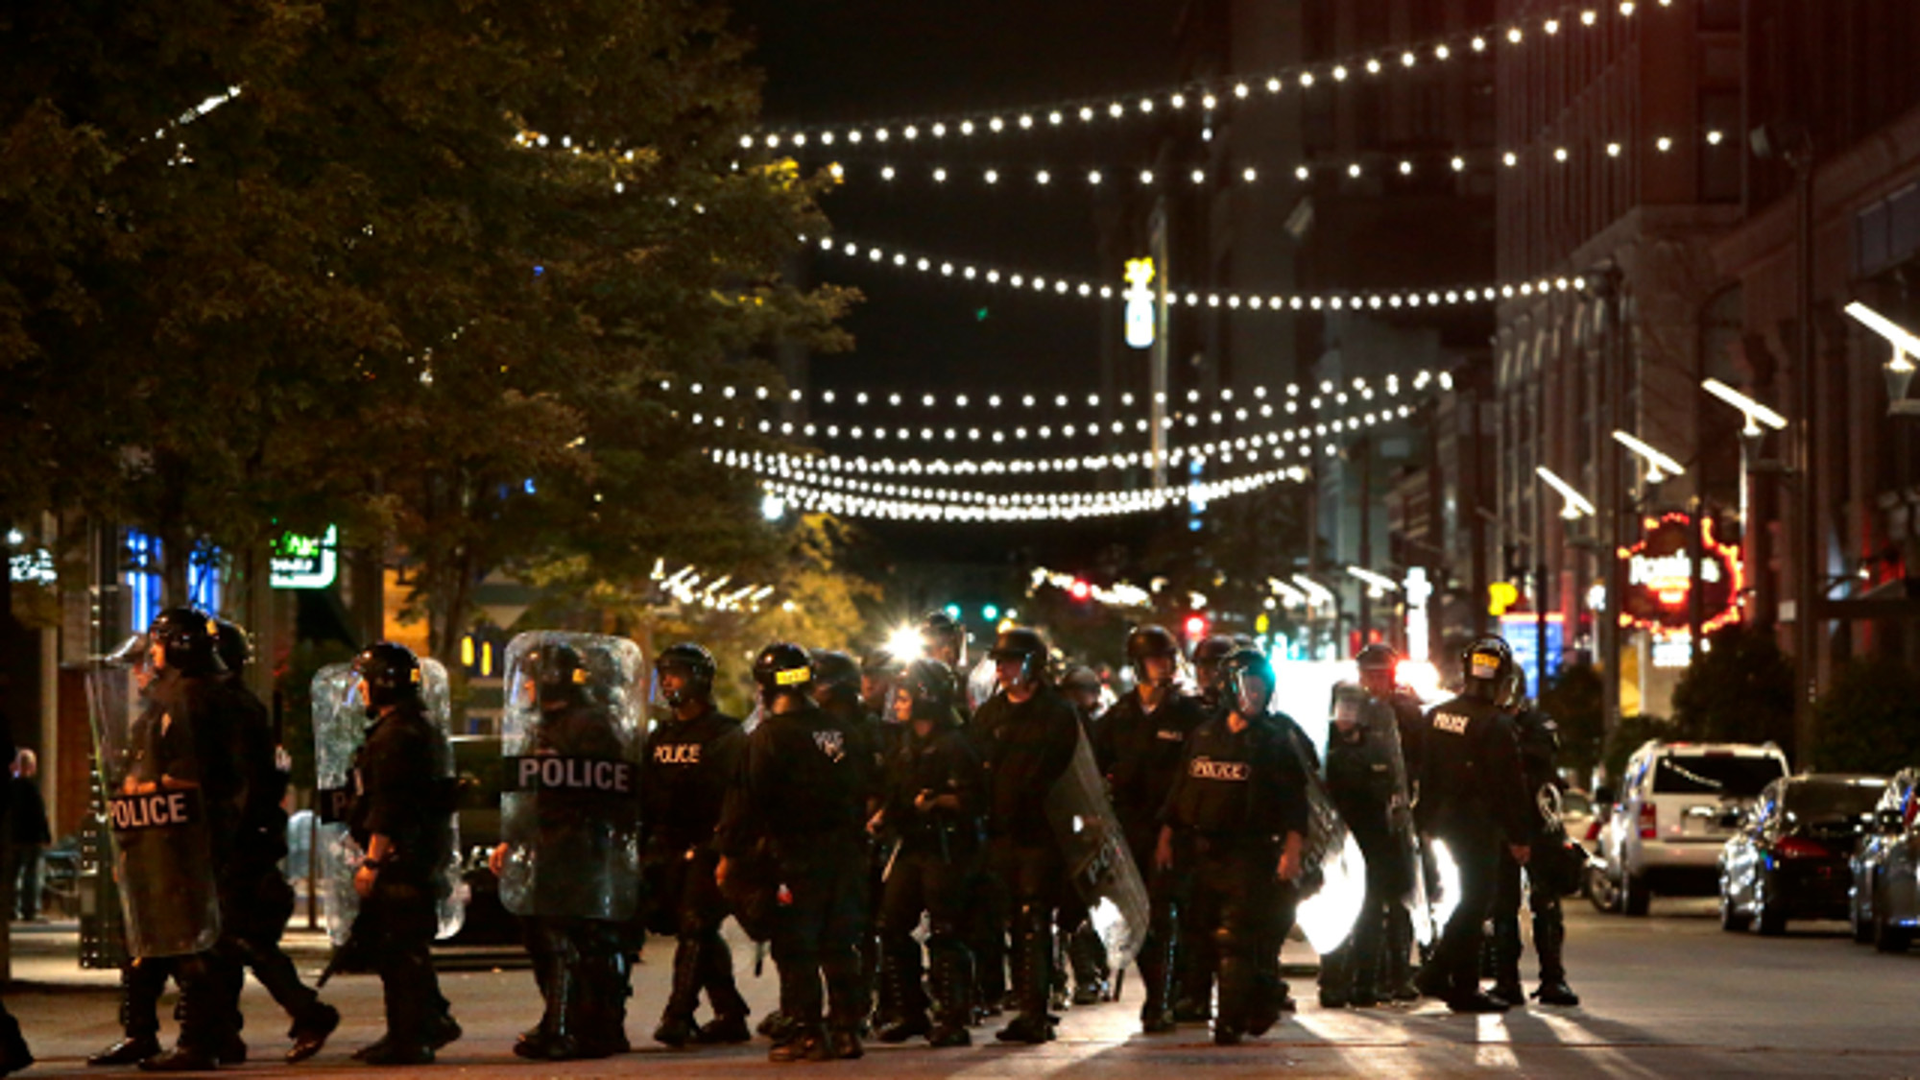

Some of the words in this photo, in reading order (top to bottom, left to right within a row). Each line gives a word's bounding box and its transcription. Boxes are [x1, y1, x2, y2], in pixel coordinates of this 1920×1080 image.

[654, 743, 701, 763] POLICE
[518, 758, 630, 792] POLICE
[1192, 761, 1243, 779] POLICE
[108, 794, 188, 828] POLICE
